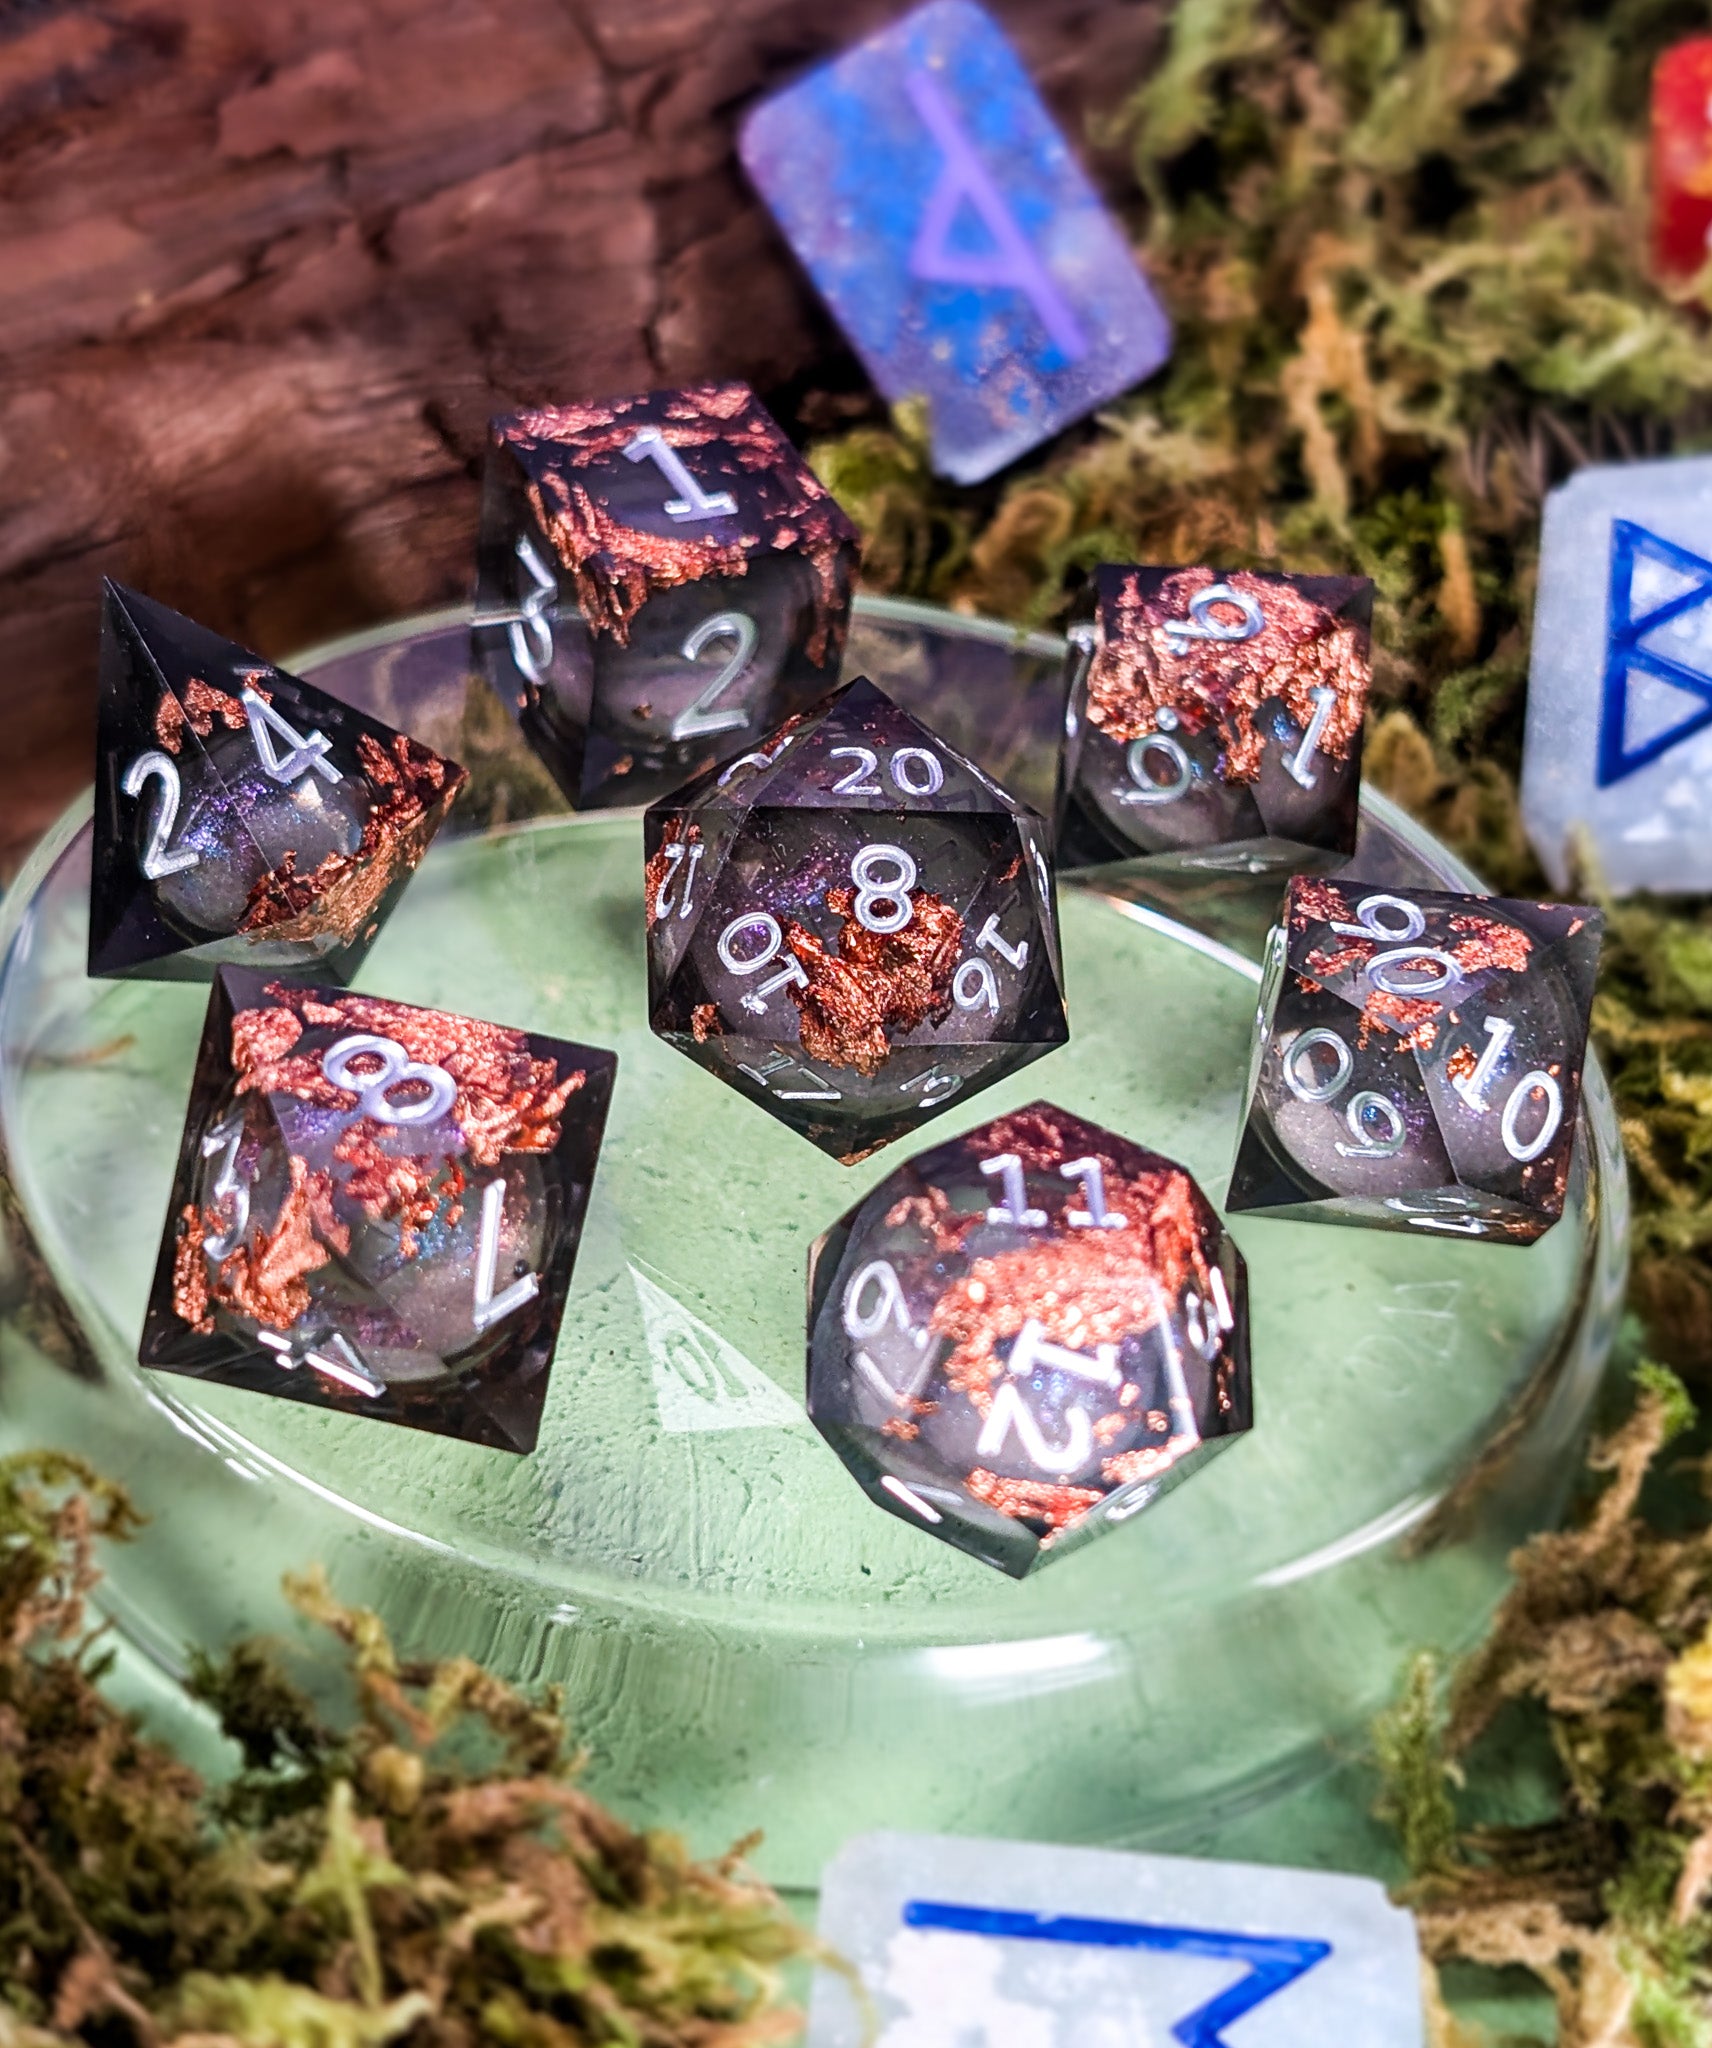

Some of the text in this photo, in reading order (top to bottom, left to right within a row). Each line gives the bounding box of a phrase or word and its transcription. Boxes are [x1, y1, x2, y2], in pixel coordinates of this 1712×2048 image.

[622, 425, 739, 523] 1
[680, 612, 758, 741] 2
[242, 687, 343, 784] 4
[829, 746, 944, 796] 20
[1281, 687, 1339, 790] 1
[122, 750, 203, 881] 2
[850, 843, 917, 934] 8
[717, 911, 810, 1015] 10
[322, 1034, 458, 1126] 8
[1451, 1014, 1564, 1163] 10
[979, 1153, 1129, 1230] 11
[975, 1318, 1125, 1474] 12
